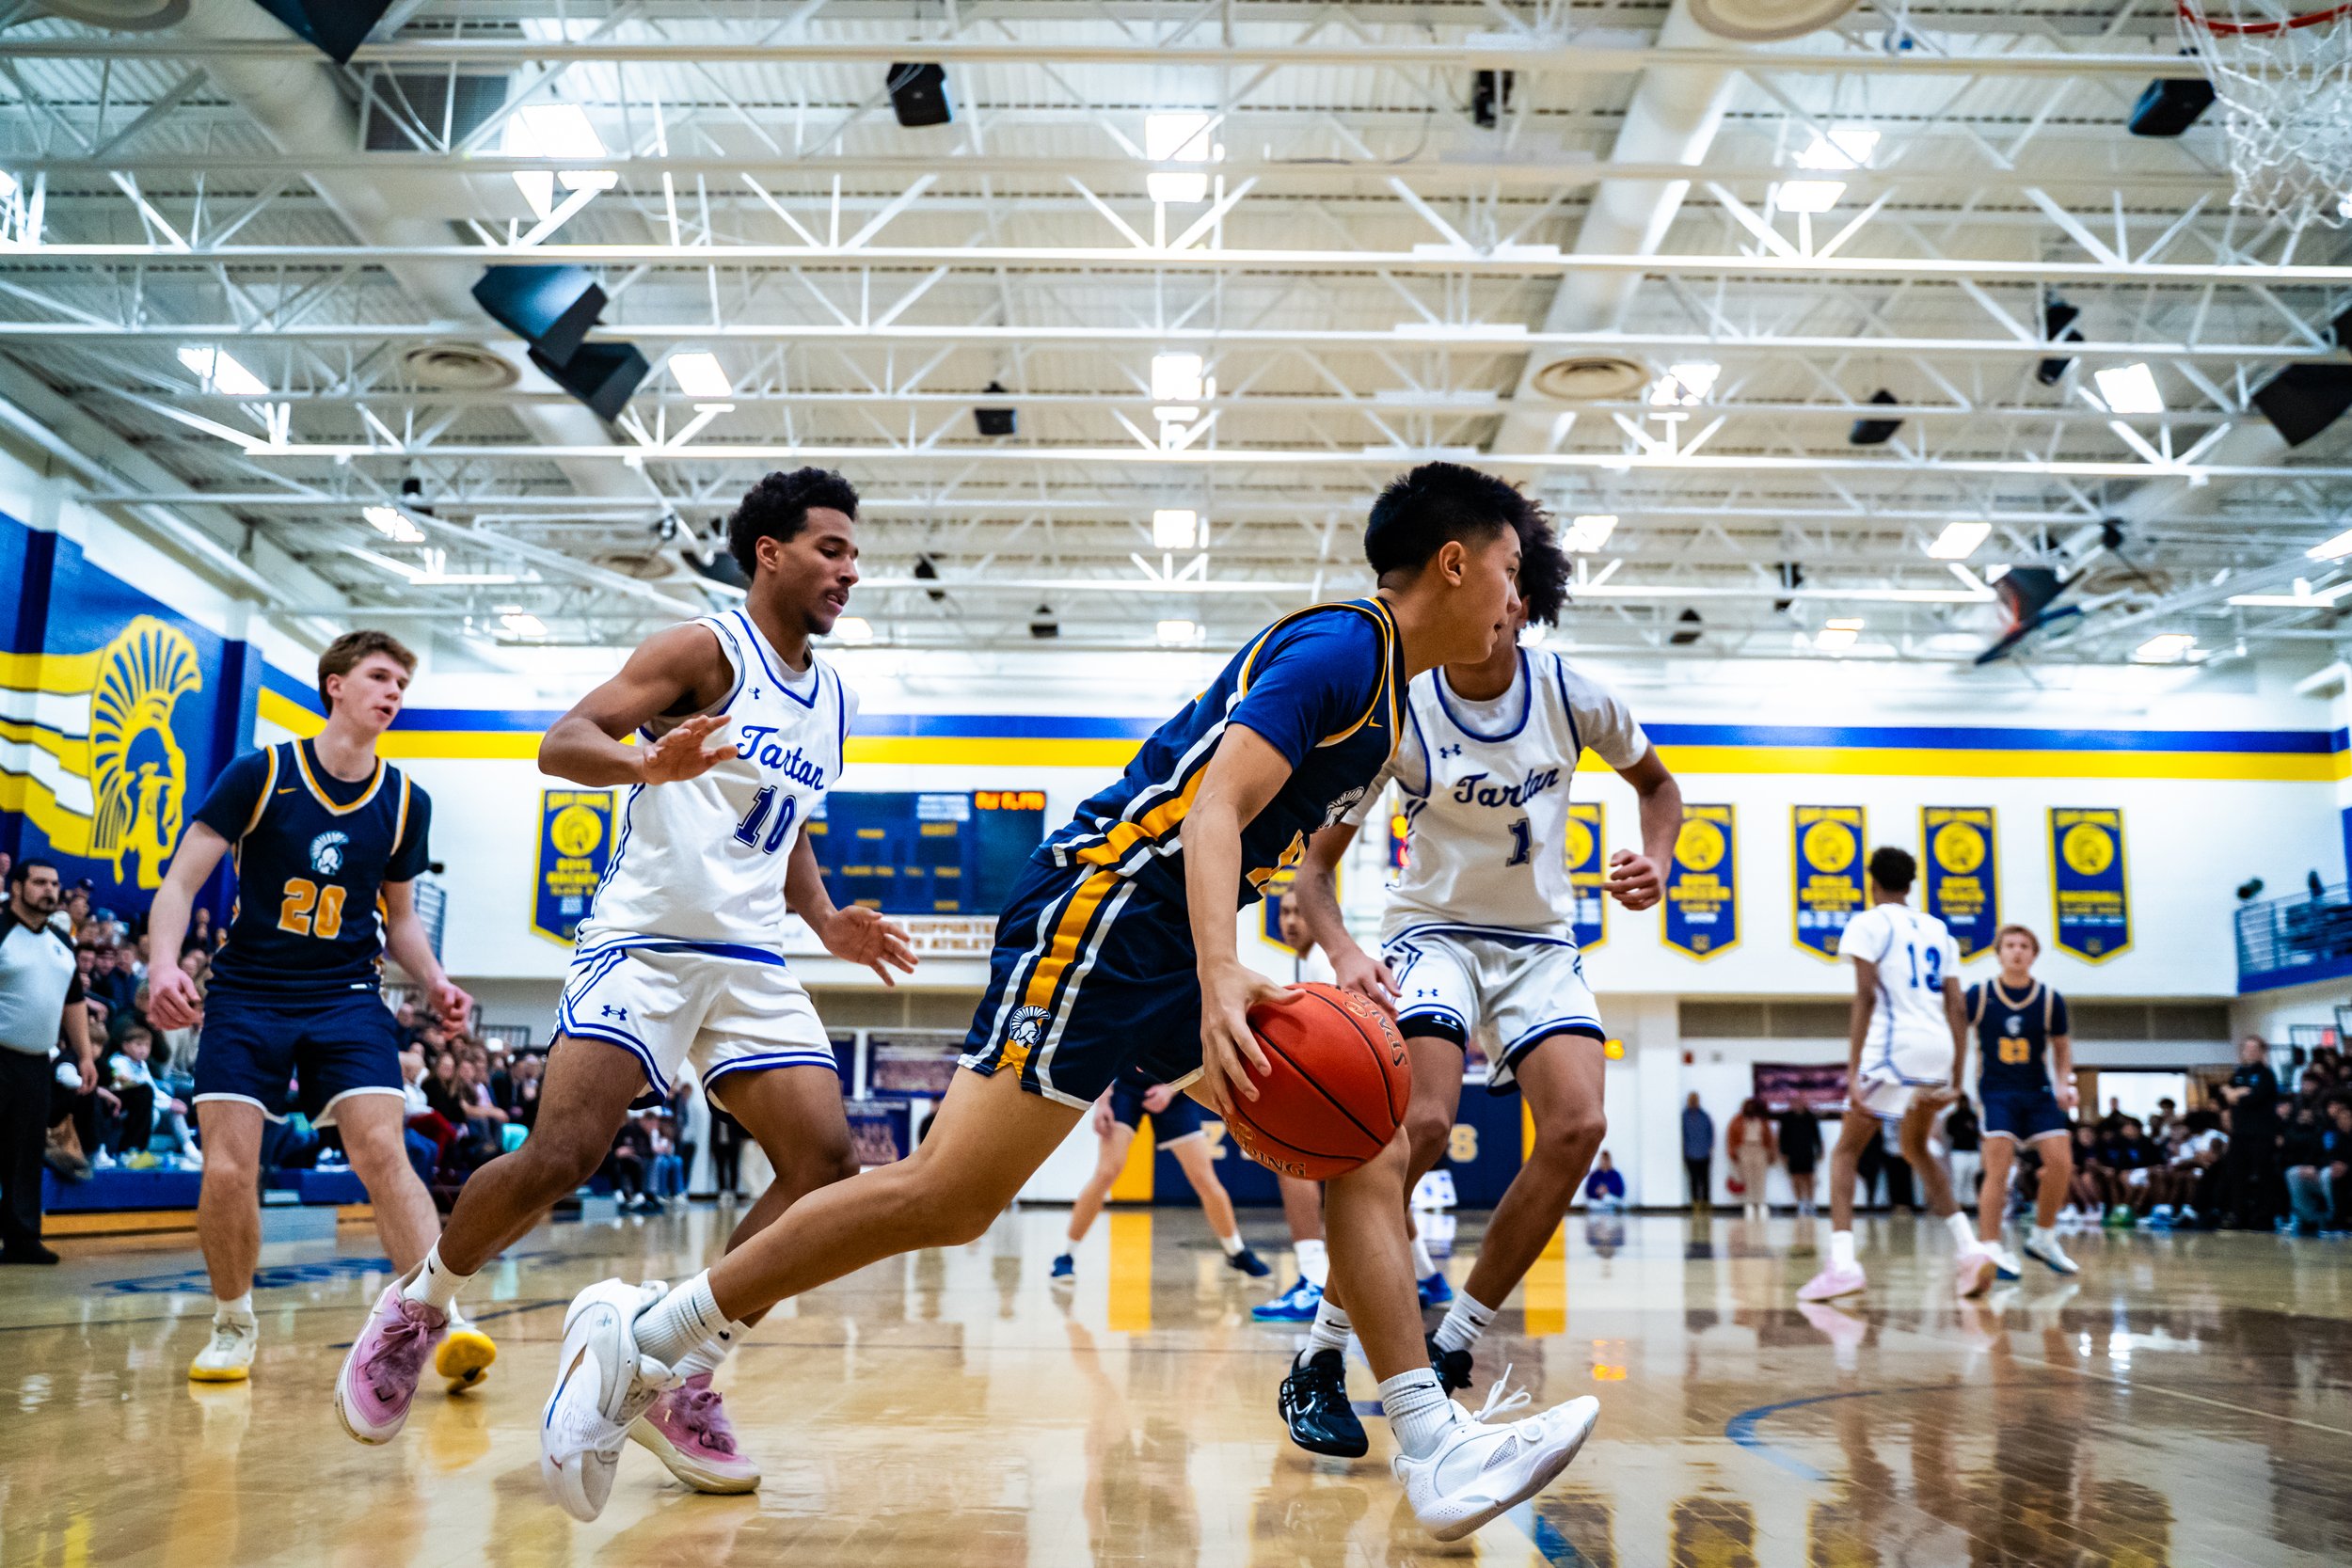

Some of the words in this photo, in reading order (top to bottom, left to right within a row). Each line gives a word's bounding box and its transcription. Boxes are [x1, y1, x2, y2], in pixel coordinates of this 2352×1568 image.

[736, 724, 824, 791] Tartan
[1454, 768, 1559, 808] Tartan
[734, 784, 797, 855] 10
[1505, 817, 1533, 867] 1
[277, 877, 347, 940] 20
